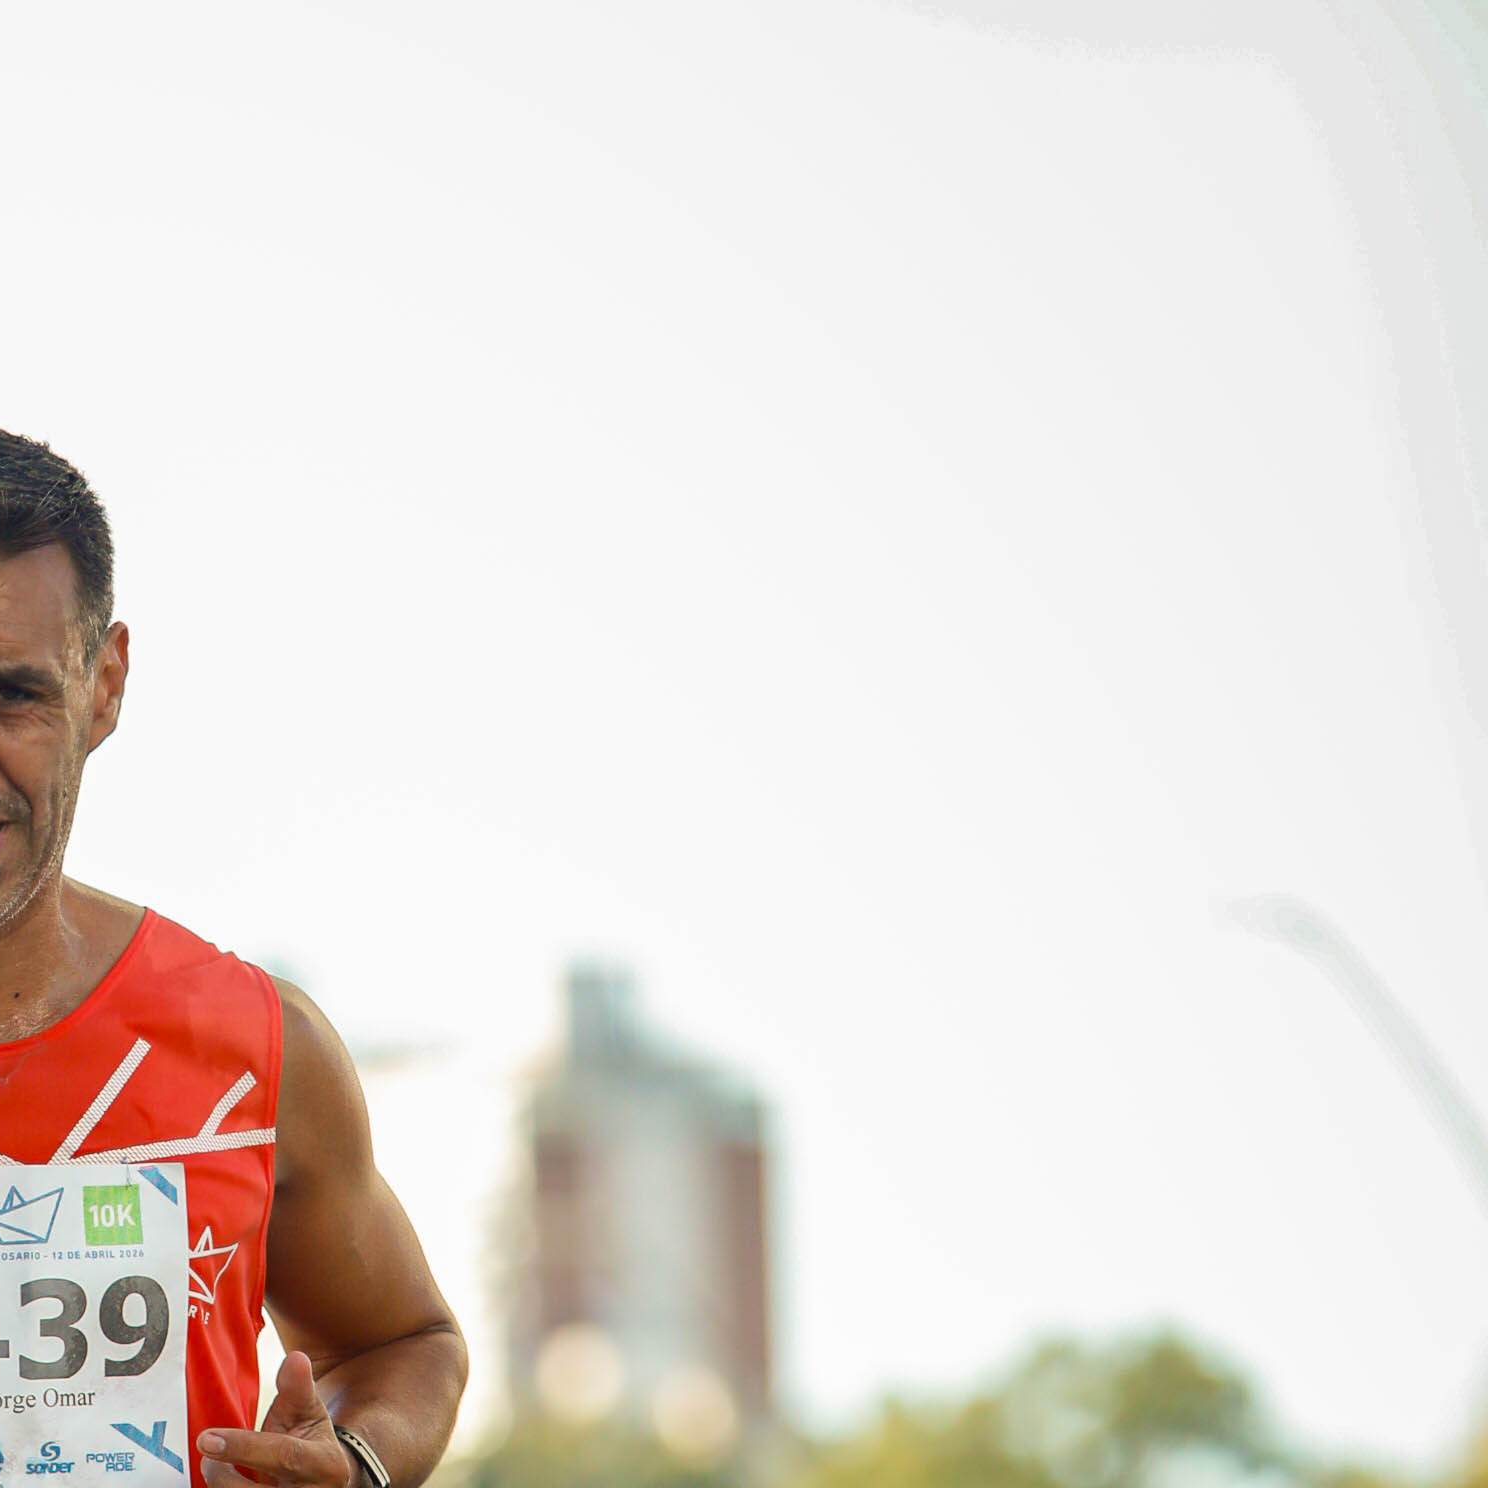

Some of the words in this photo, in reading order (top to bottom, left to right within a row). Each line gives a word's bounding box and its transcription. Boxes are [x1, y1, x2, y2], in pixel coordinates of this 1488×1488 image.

[89, 1203, 137, 1228] 10K
[52, 1250, 63, 1260] 12
[67, 1250, 81, 1260] DE
[84, 1249, 115, 1259] ABRIL
[119, 1248, 144, 1258] 2026
[43, 1387, 96, 1408] Omar
[86, 1452, 135, 1463] POWER
